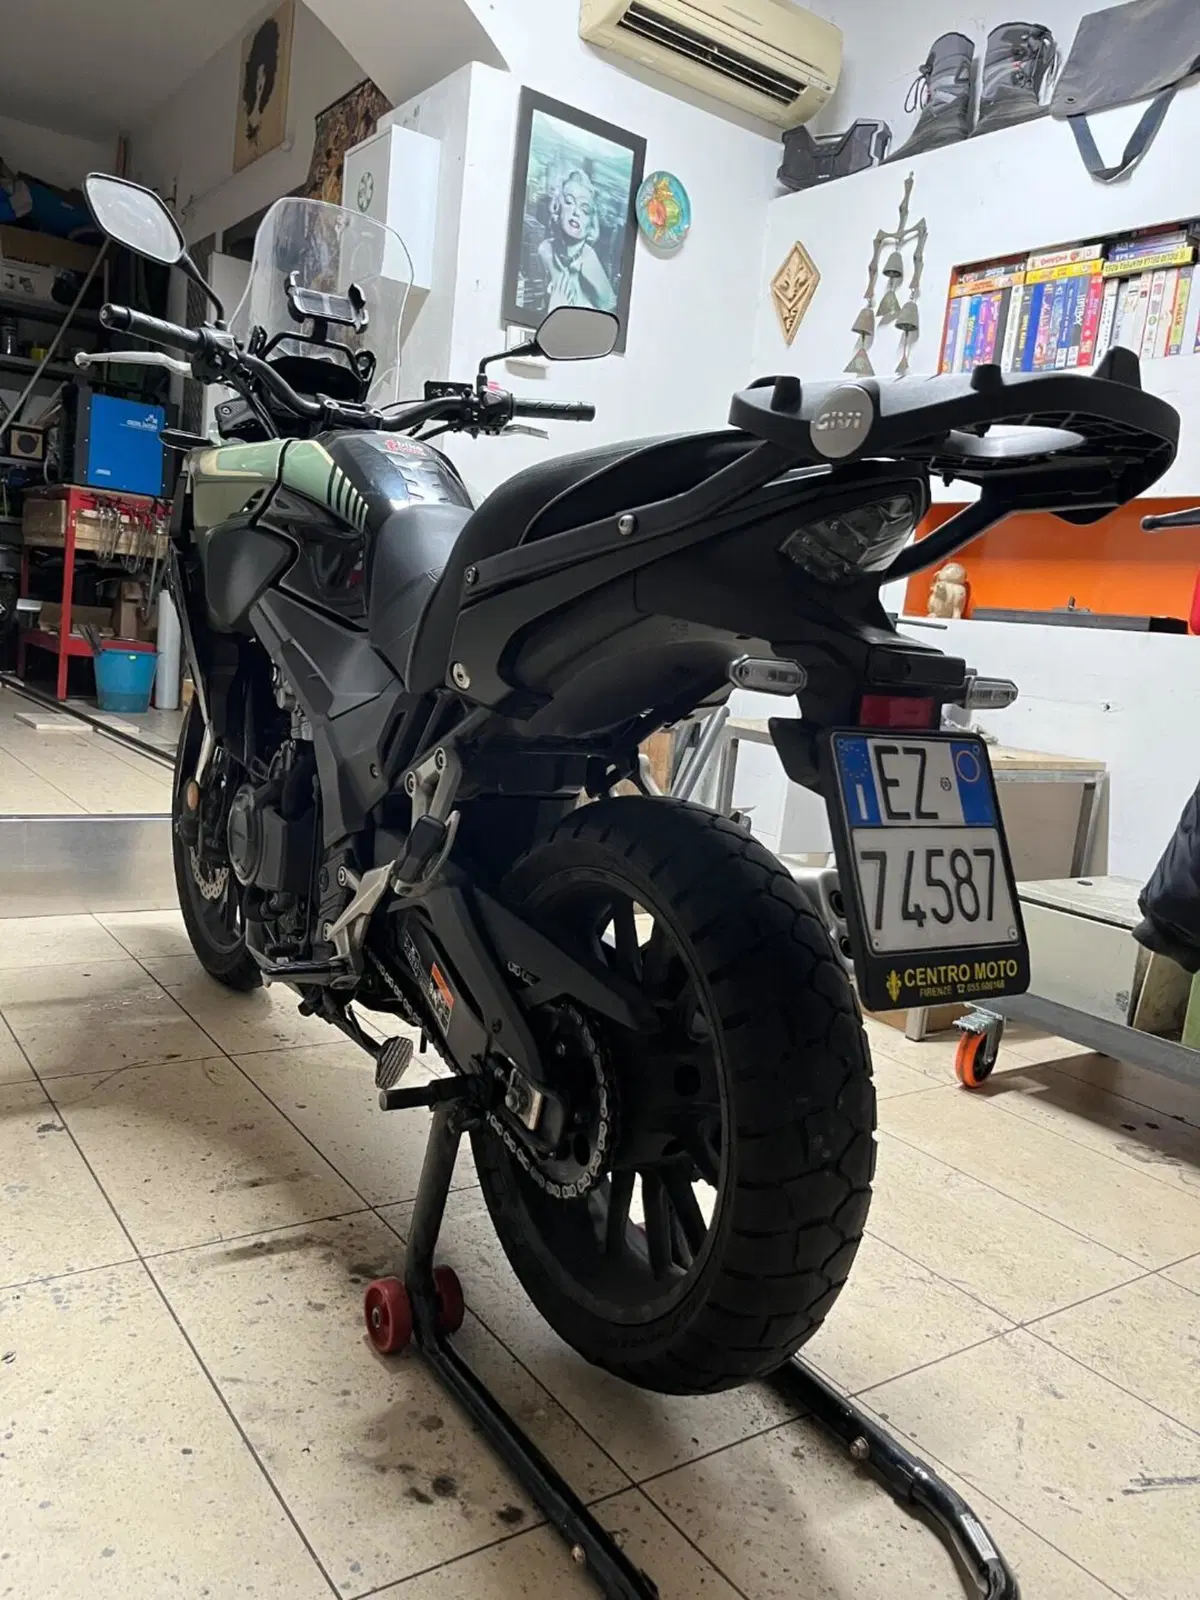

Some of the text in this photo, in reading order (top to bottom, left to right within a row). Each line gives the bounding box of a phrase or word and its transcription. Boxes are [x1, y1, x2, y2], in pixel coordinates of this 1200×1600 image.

[816, 410, 862, 431] GIVI
[873, 744, 939, 820] EZ
[860, 848, 995, 930] 74587
[904, 959, 1018, 987] CENTRO MOTO
[919, 985, 952, 998] FIRENZE
